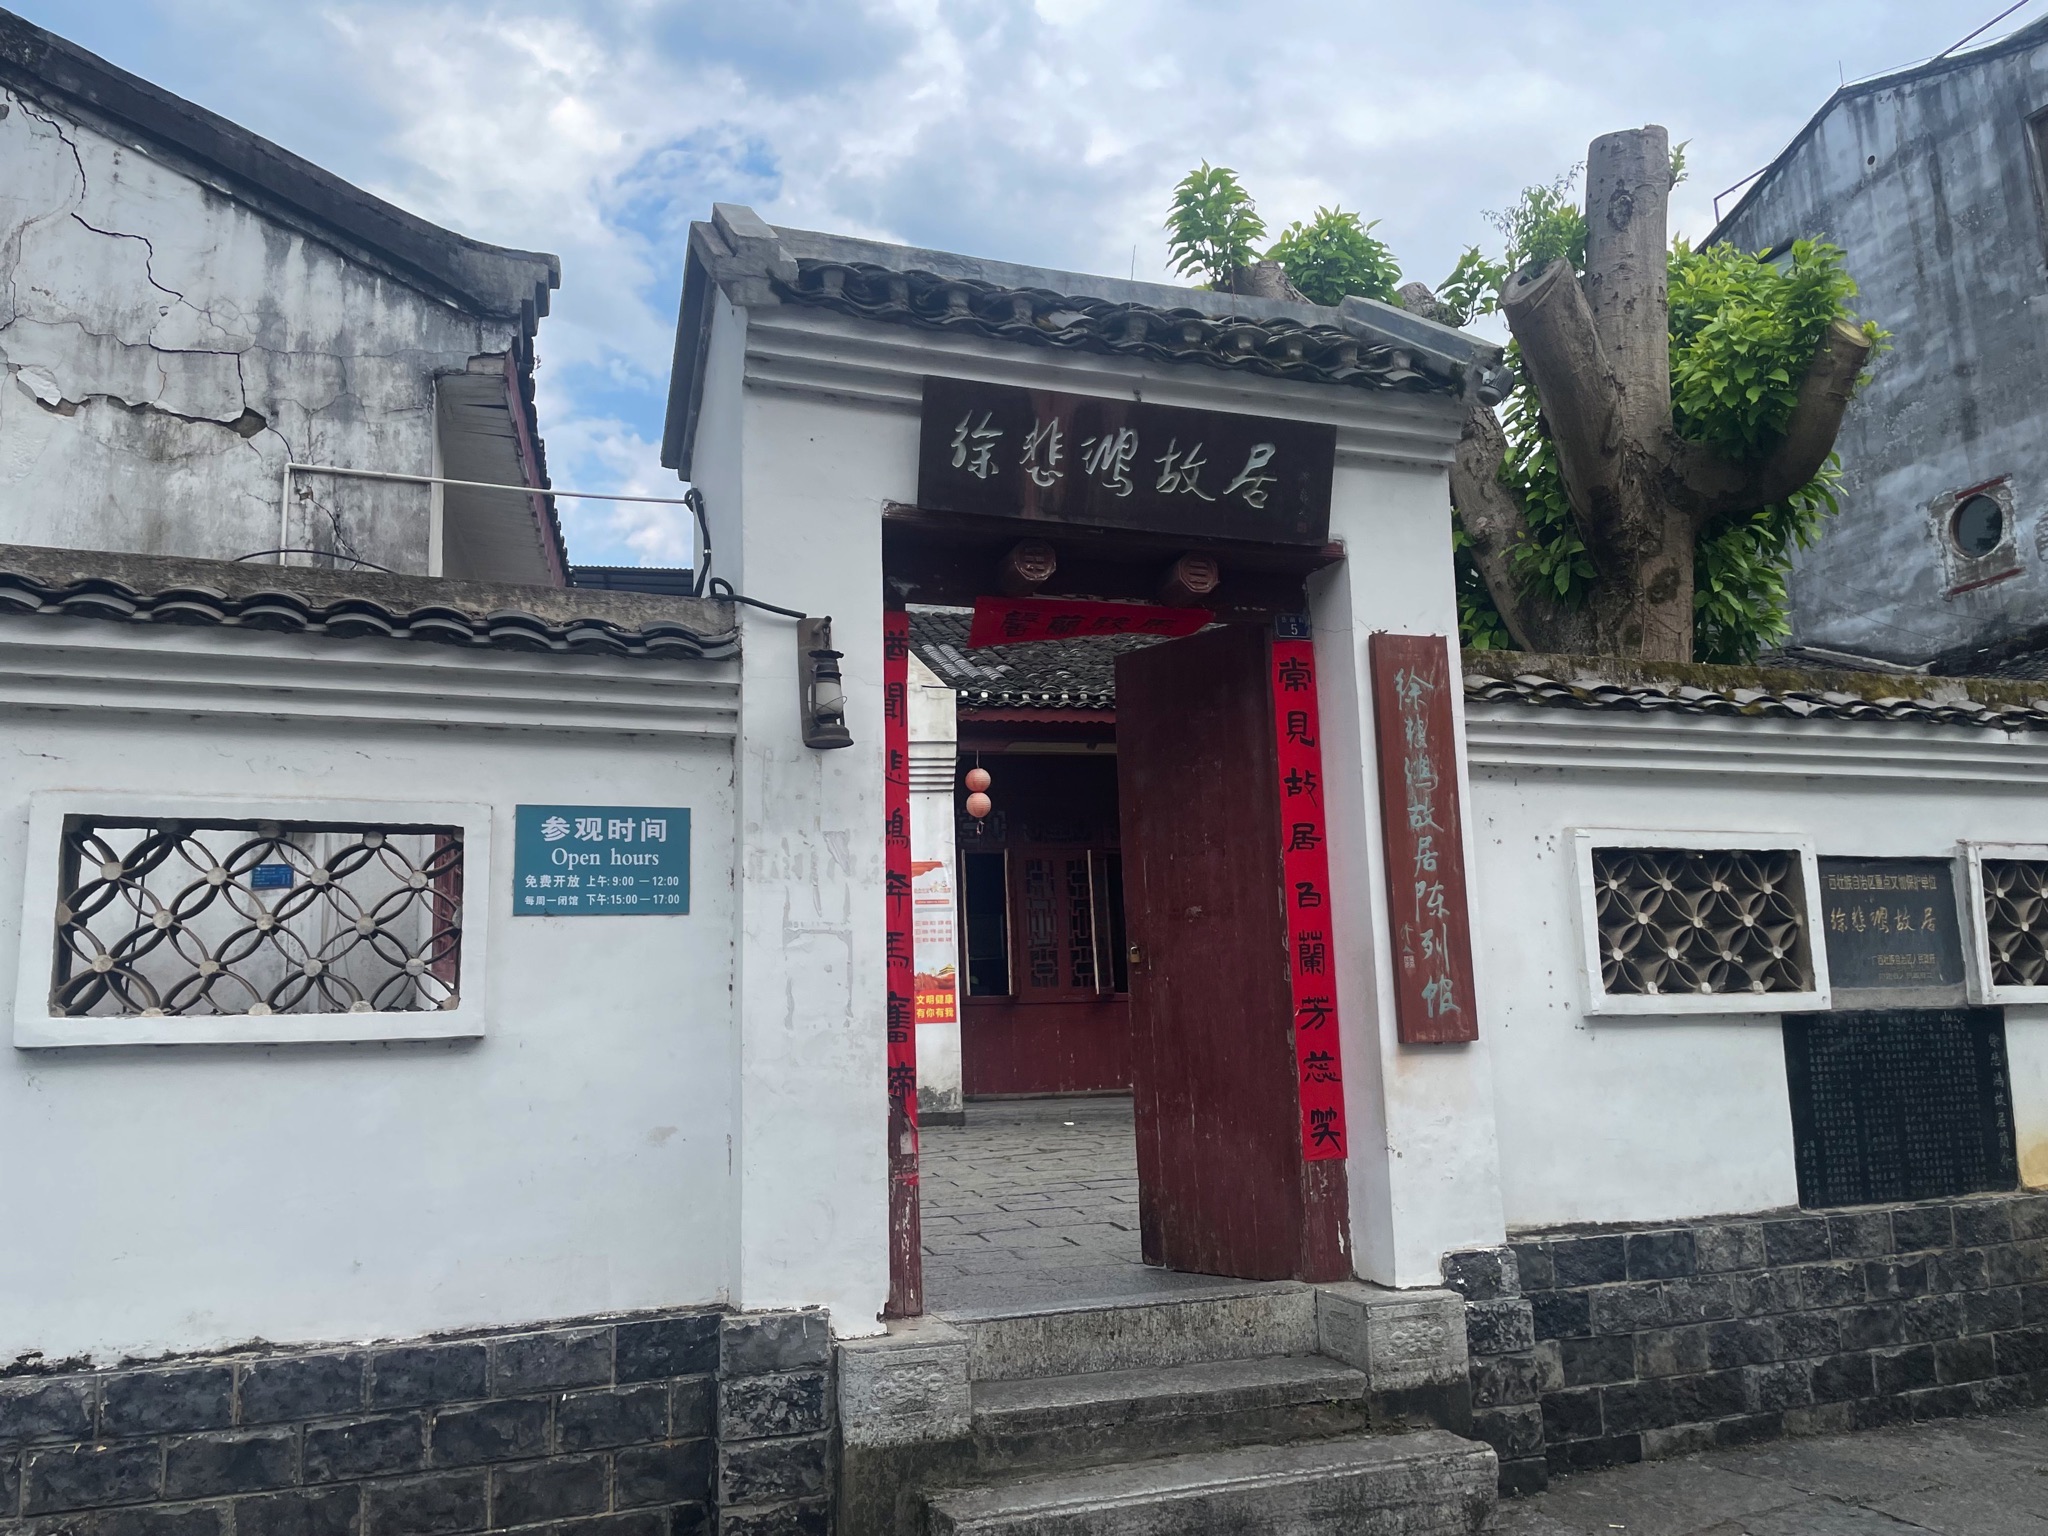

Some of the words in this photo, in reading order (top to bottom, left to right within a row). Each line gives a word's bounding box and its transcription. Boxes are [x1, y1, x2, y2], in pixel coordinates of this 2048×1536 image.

[1290, 623, 1298, 635] 5
[541, 815, 667, 843] 参观时间
[551, 847, 601, 871] Open
[610, 847, 660, 866] hours
[524, 874, 581, 888] 免费开放
[524, 895, 579, 907] 每周一闭馆
[916, 994, 954, 1005] 文明健康
[916, 1007, 955, 1018] 有你有我
